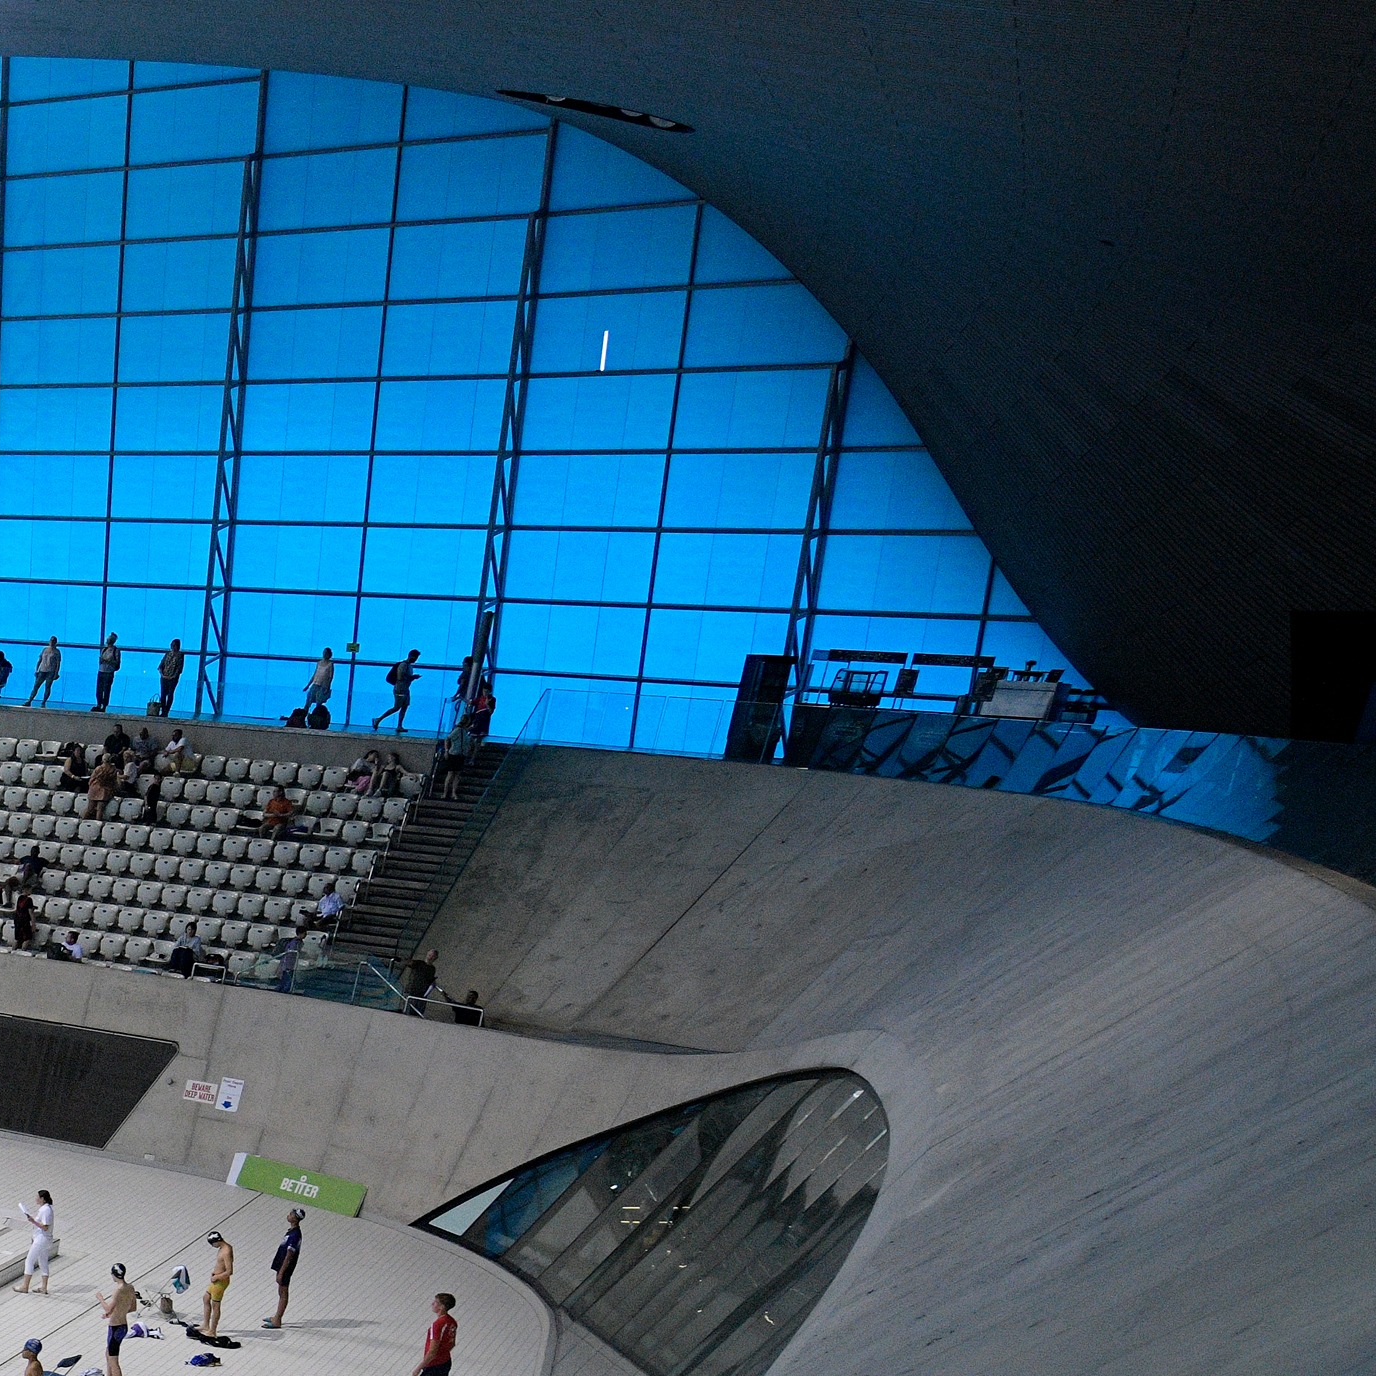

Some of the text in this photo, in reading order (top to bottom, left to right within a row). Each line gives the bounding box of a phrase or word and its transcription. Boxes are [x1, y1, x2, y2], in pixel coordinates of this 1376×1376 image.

[191, 1082, 212, 1093] BEWARE
[184, 1090, 215, 1102] DEEP WATER
[280, 1177, 319, 1198] BETTER
